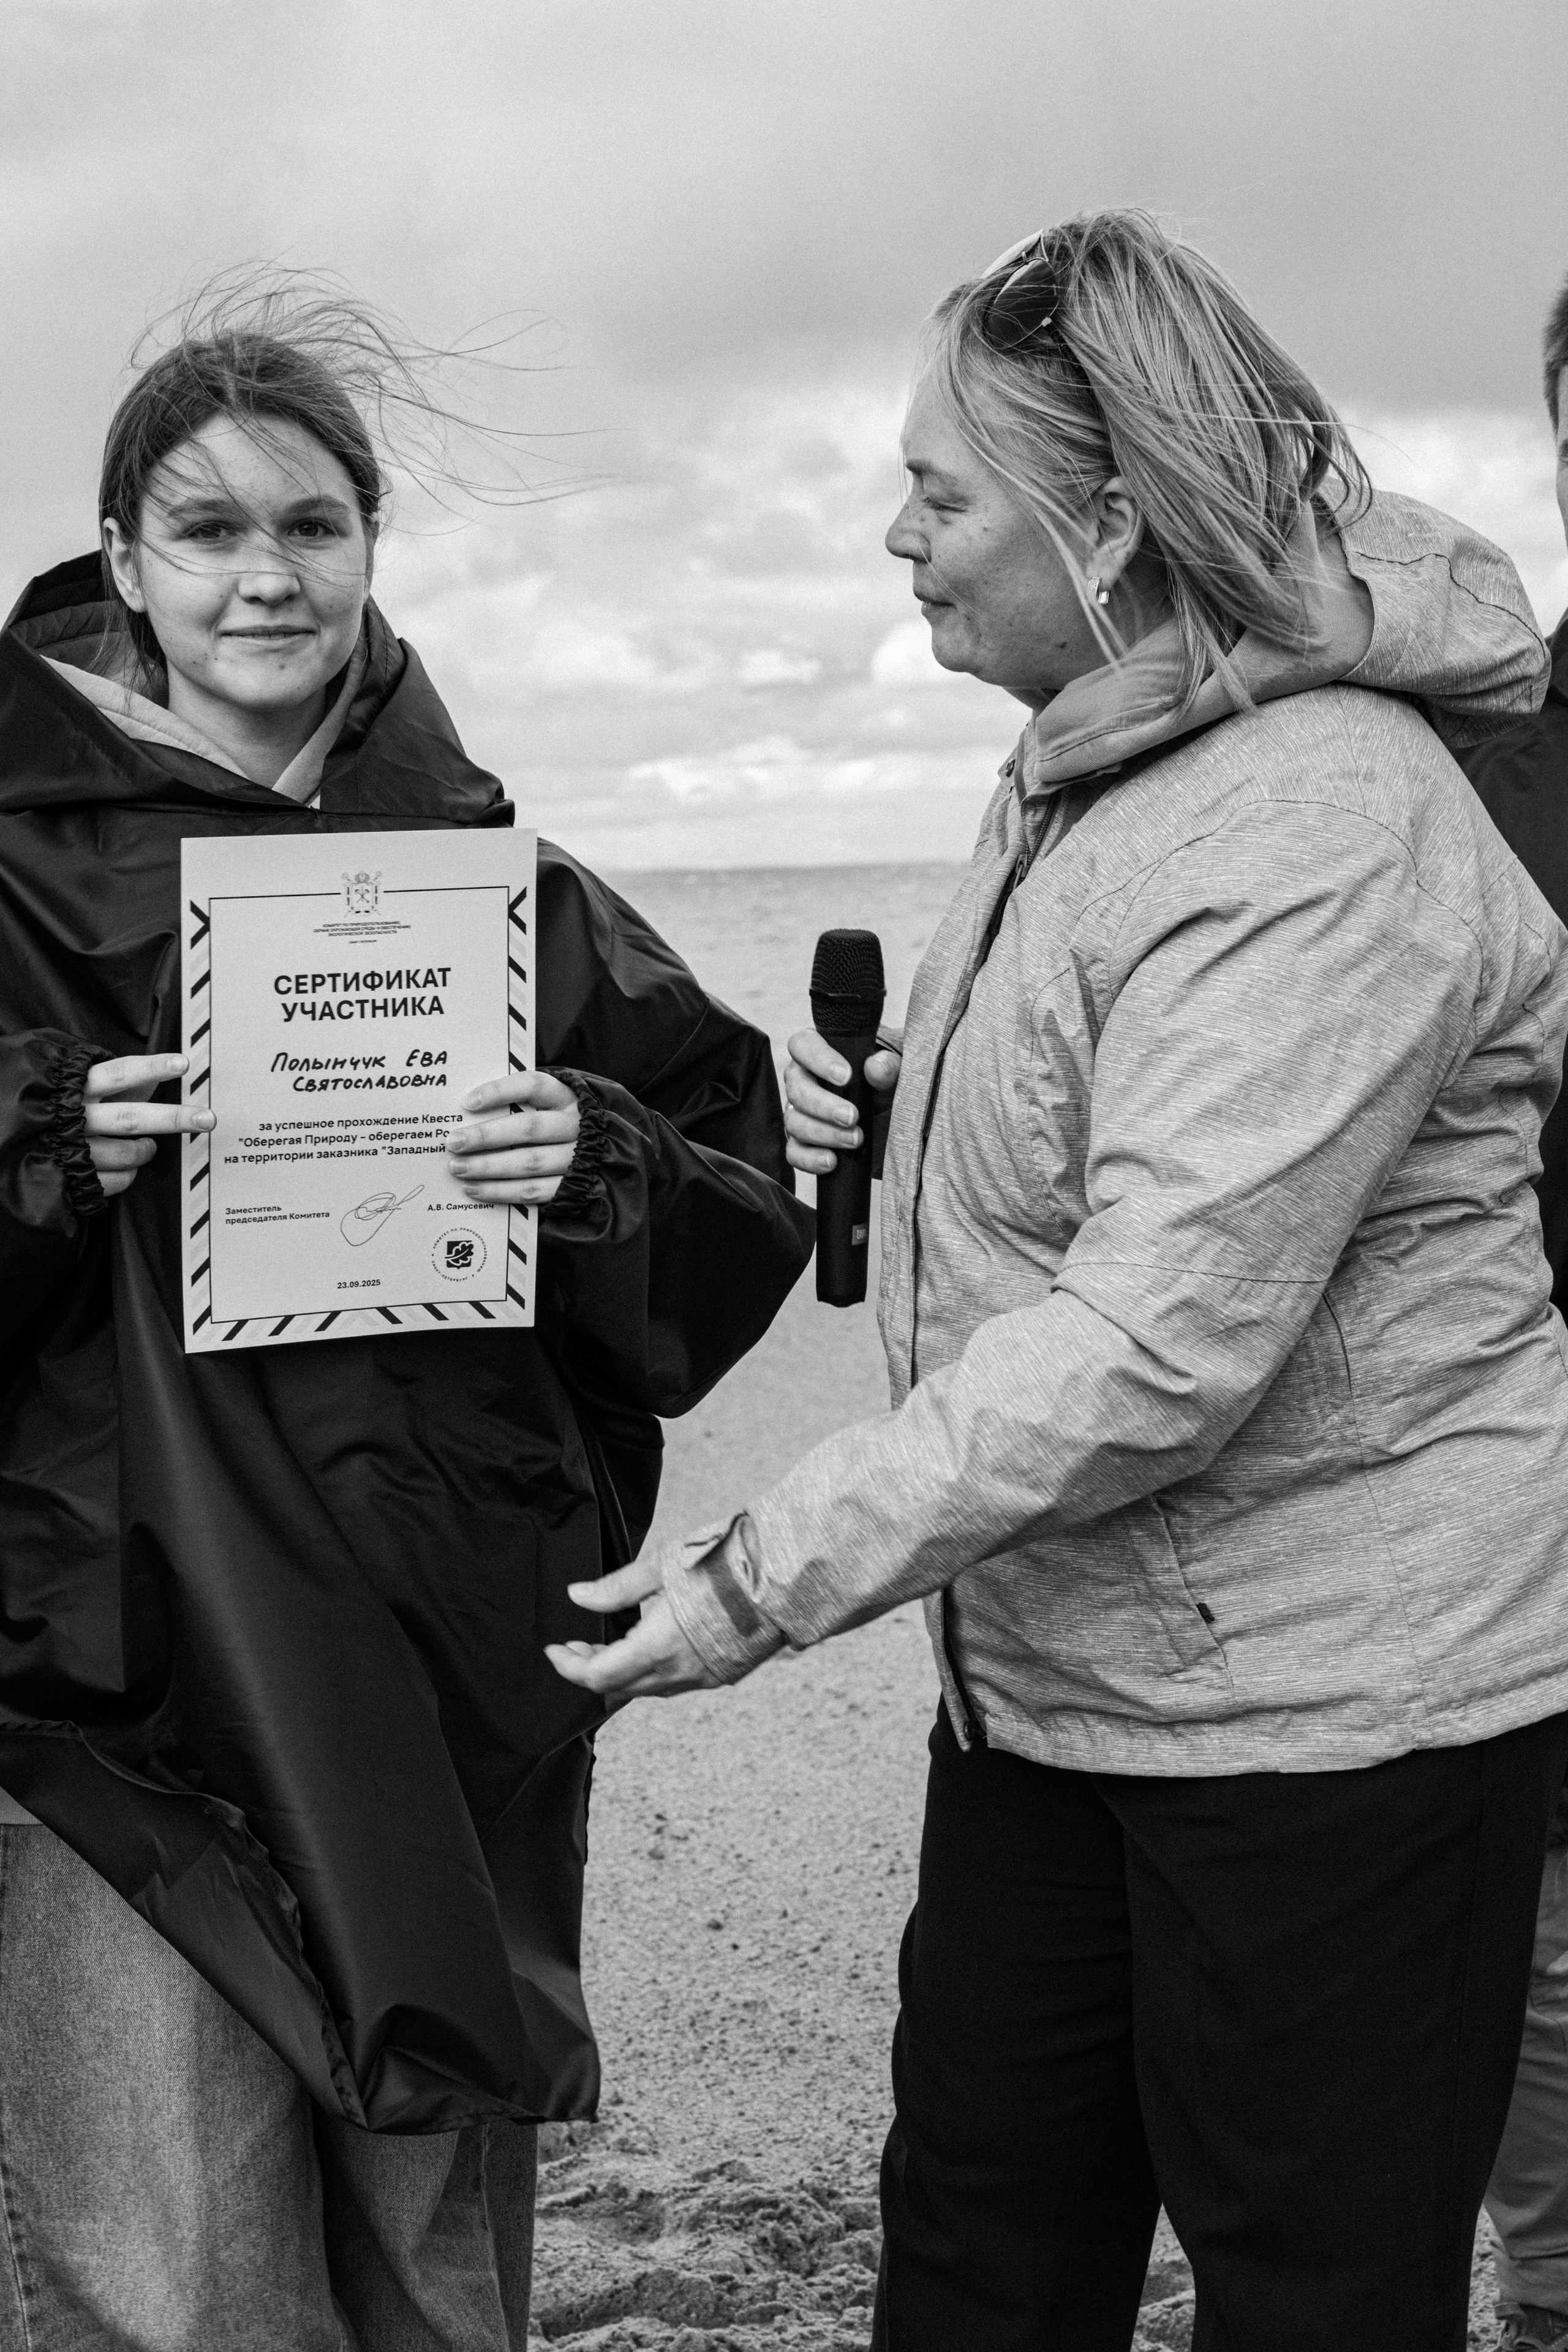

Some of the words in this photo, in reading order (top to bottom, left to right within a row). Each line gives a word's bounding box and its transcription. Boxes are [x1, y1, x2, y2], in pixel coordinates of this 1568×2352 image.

[274, 967, 451, 995] СЕРТИФИКАТ
[281, 995, 444, 1022] УЧАСТНИКА
[258, 1123, 273, 1131] за
[275, 1120, 334, 1133] успешное
[337, 1117, 419, 1129] прохождение
[422, 1114, 463, 1124] Квеста
[238, 1137, 302, 1148] "Оберегая
[305, 1134, 358, 1147] Природу
[369, 1131, 432, 1142] оберегаем
[241, 1152, 314, 1164] территории
[316, 1148, 378, 1159] заказника
[382, 1144, 446, 1155] "Западный
[225, 1205, 282, 1215] Заместитель
[225, 1214, 287, 1225] председателя
[289, 1212, 330, 1220] Комитета
[433, 1231, 450, 1249] КОМИТЕТ
[337, 1279, 381, 1289] 23.09.2025
